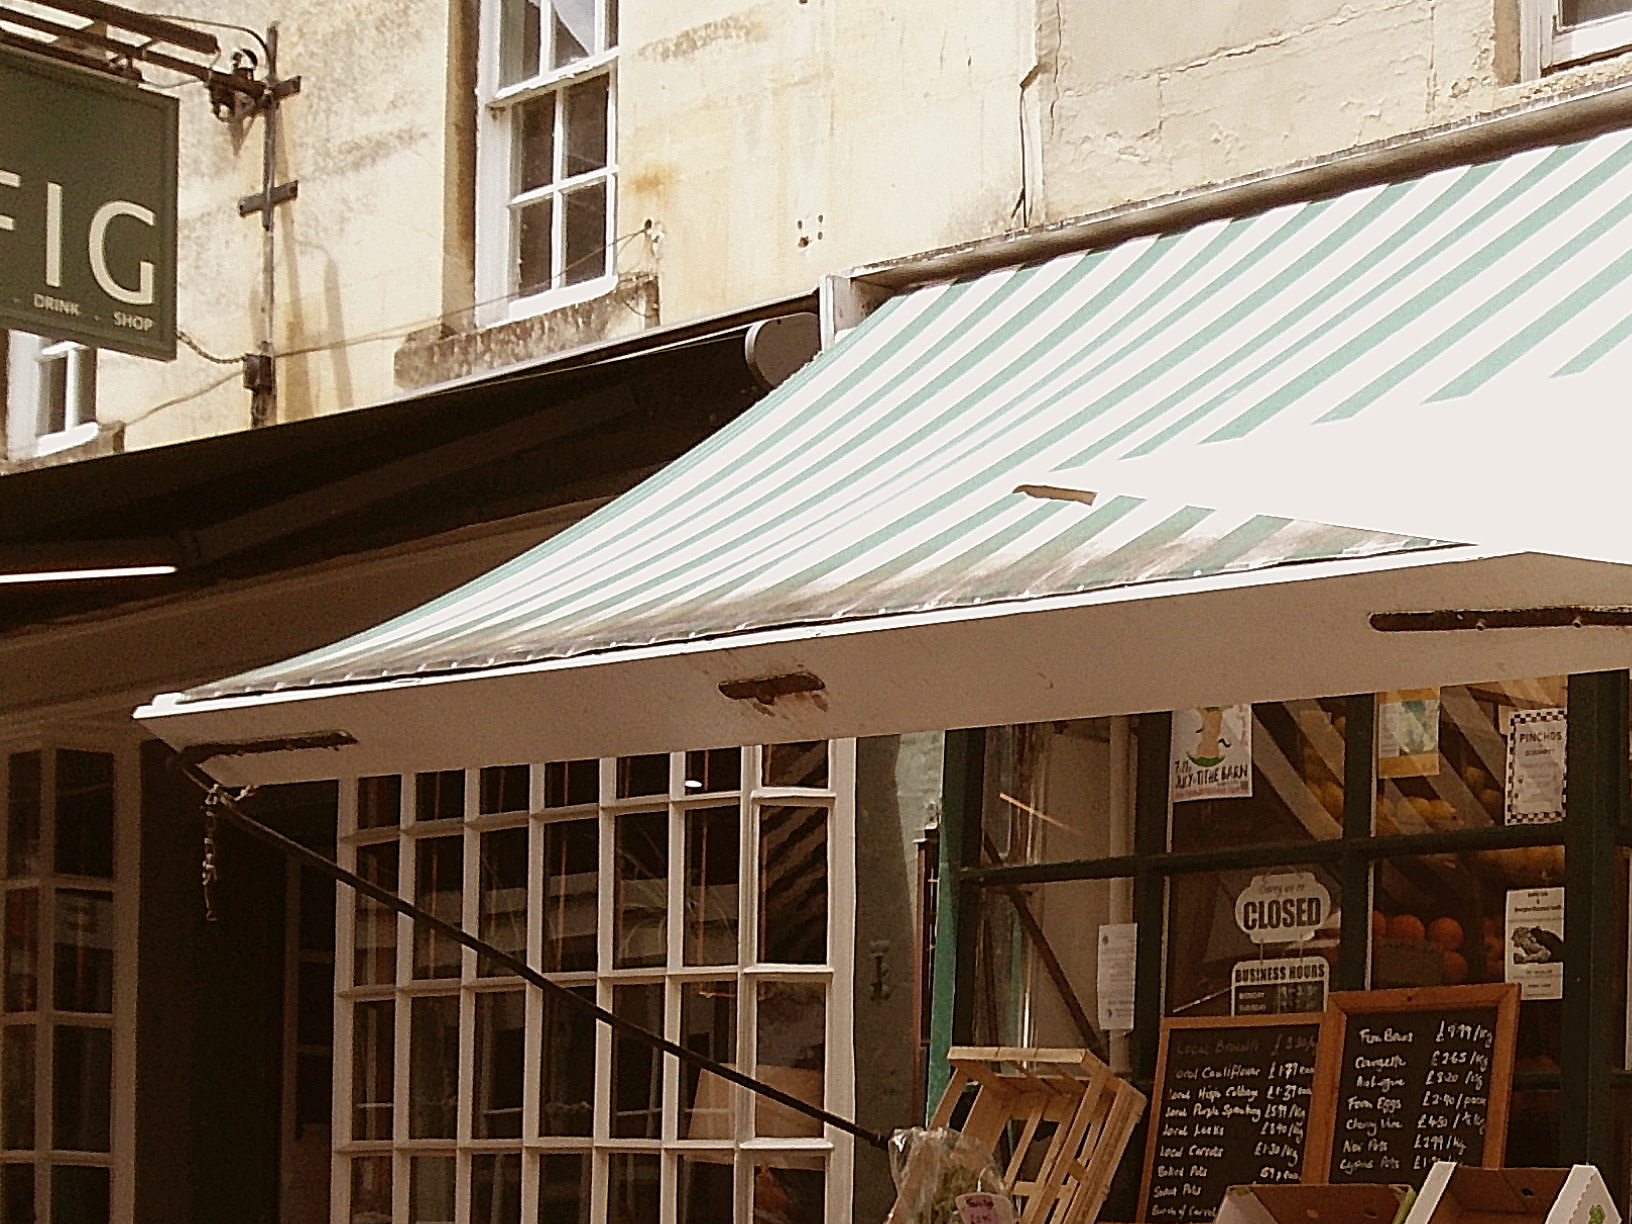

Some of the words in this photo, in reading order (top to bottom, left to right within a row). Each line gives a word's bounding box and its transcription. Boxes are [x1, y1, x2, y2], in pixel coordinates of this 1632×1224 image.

[33, 292, 81, 317] DRINK
[113, 310, 155, 332] SHOP
[1221, 763, 1249, 781] BARN
[1243, 897, 1322, 931] CLOSED
[1234, 966, 1287, 984] BUSINESS
[1289, 963, 1326, 980] HOURS
